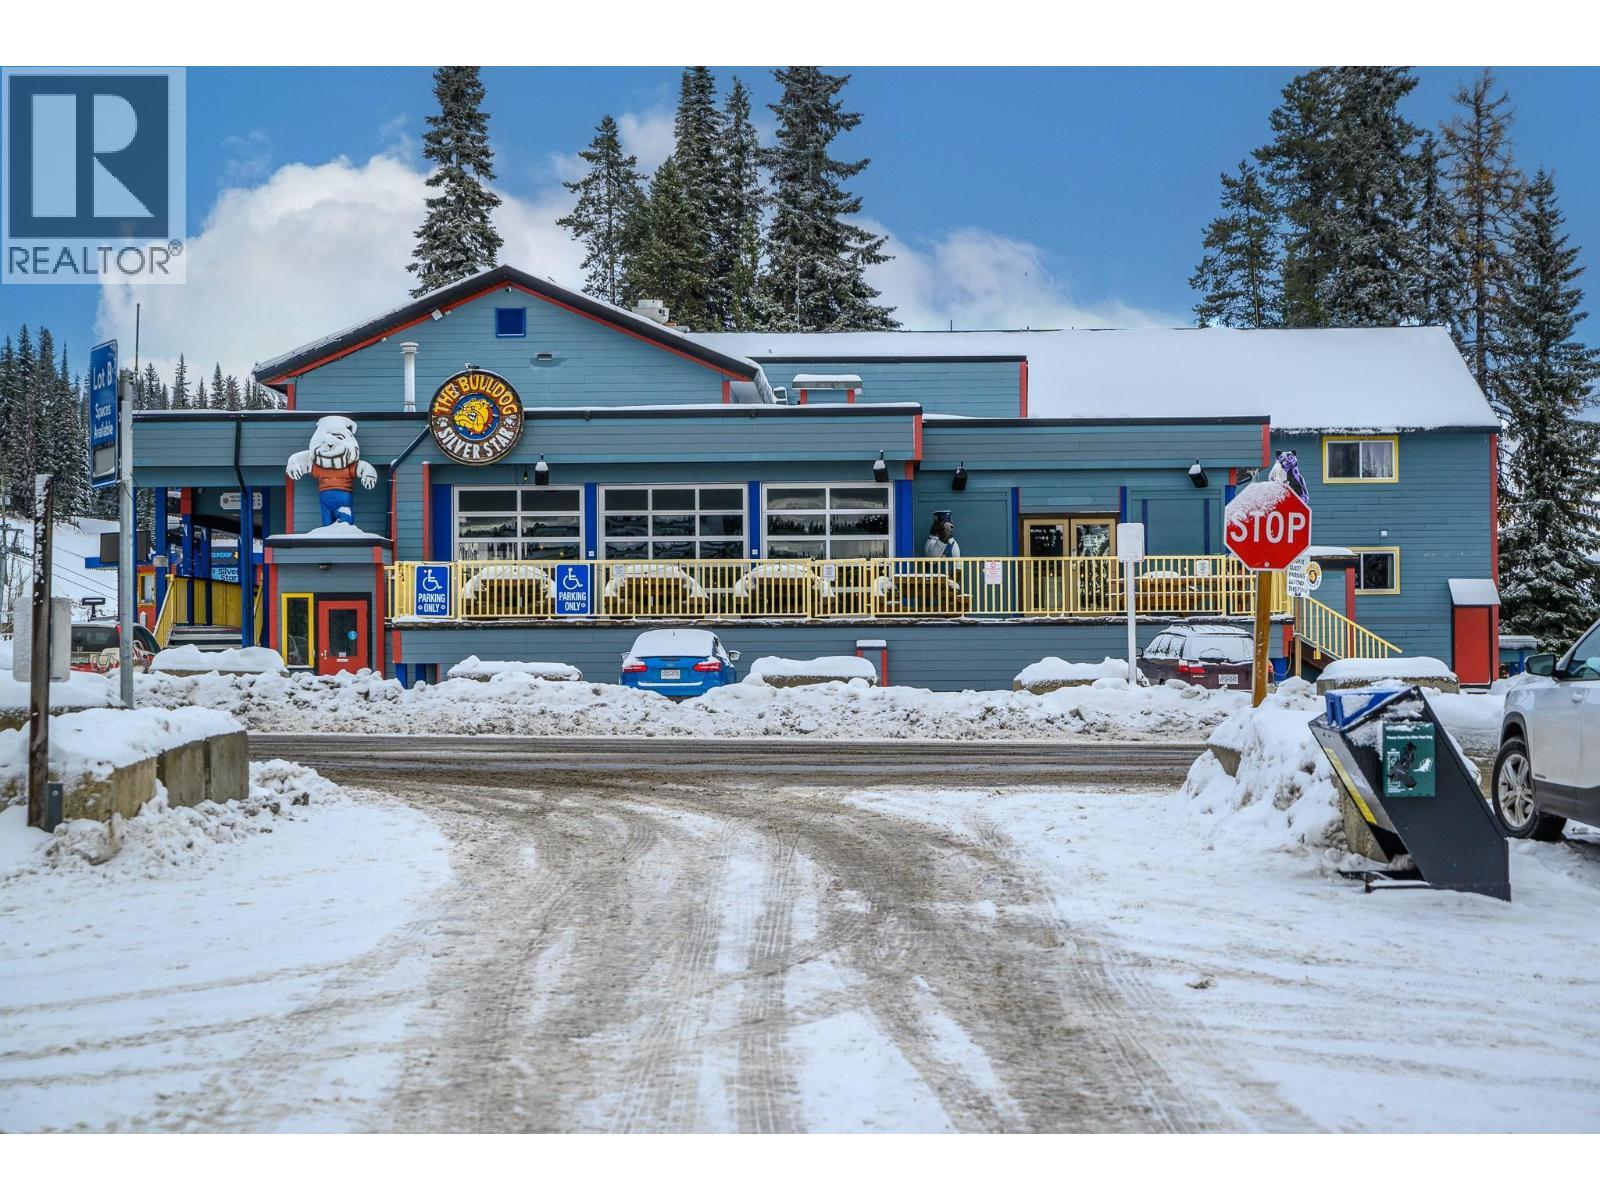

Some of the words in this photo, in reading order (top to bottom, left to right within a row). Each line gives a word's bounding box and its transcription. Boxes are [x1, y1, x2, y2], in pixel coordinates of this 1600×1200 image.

[93, 367, 106, 390] Lot
[107, 361, 113, 386] B
[433, 382, 460, 414] THE
[458, 374, 518, 415] BULLDOG
[95, 403, 112, 419] Spaces
[94, 421, 113, 439] Available
[437, 427, 480, 459] SILVER
[483, 427, 514, 457] STAR
[1230, 511, 1306, 543] STOP
[418, 593, 446, 603] PARKING
[559, 592, 586, 601] PARKING
[424, 604, 440, 612] ONLY
[565, 602, 580, 611] ONLY
